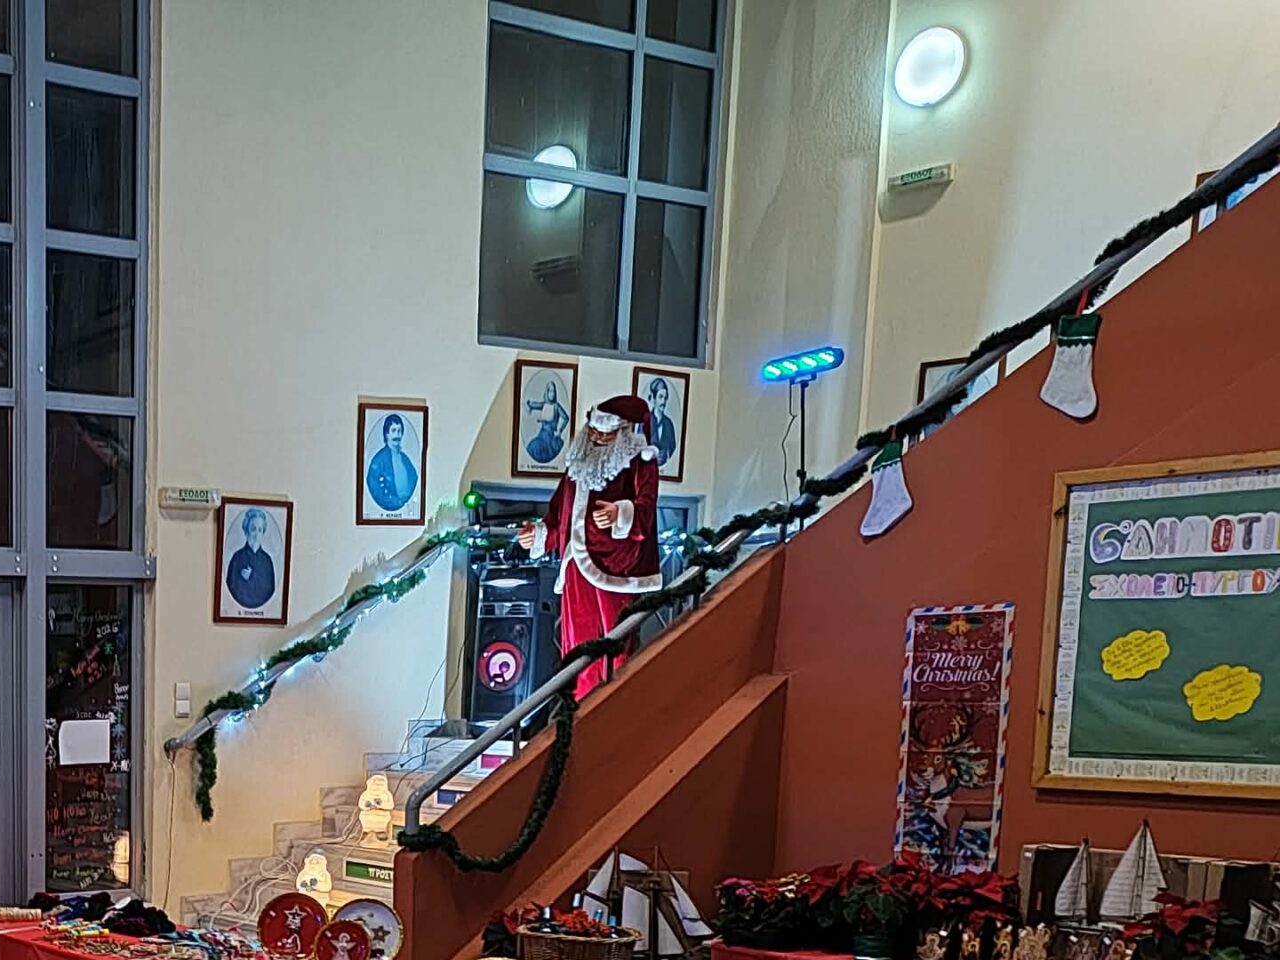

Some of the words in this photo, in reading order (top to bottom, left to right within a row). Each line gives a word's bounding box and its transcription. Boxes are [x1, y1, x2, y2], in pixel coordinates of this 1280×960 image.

[178, 488, 208, 499] ΕΞΟΔΟΣ
[931, 652, 984, 673] Merry
[913, 661, 1001, 684] Christmas!
[368, 867, 392, 881] ΠΡΟΣ
